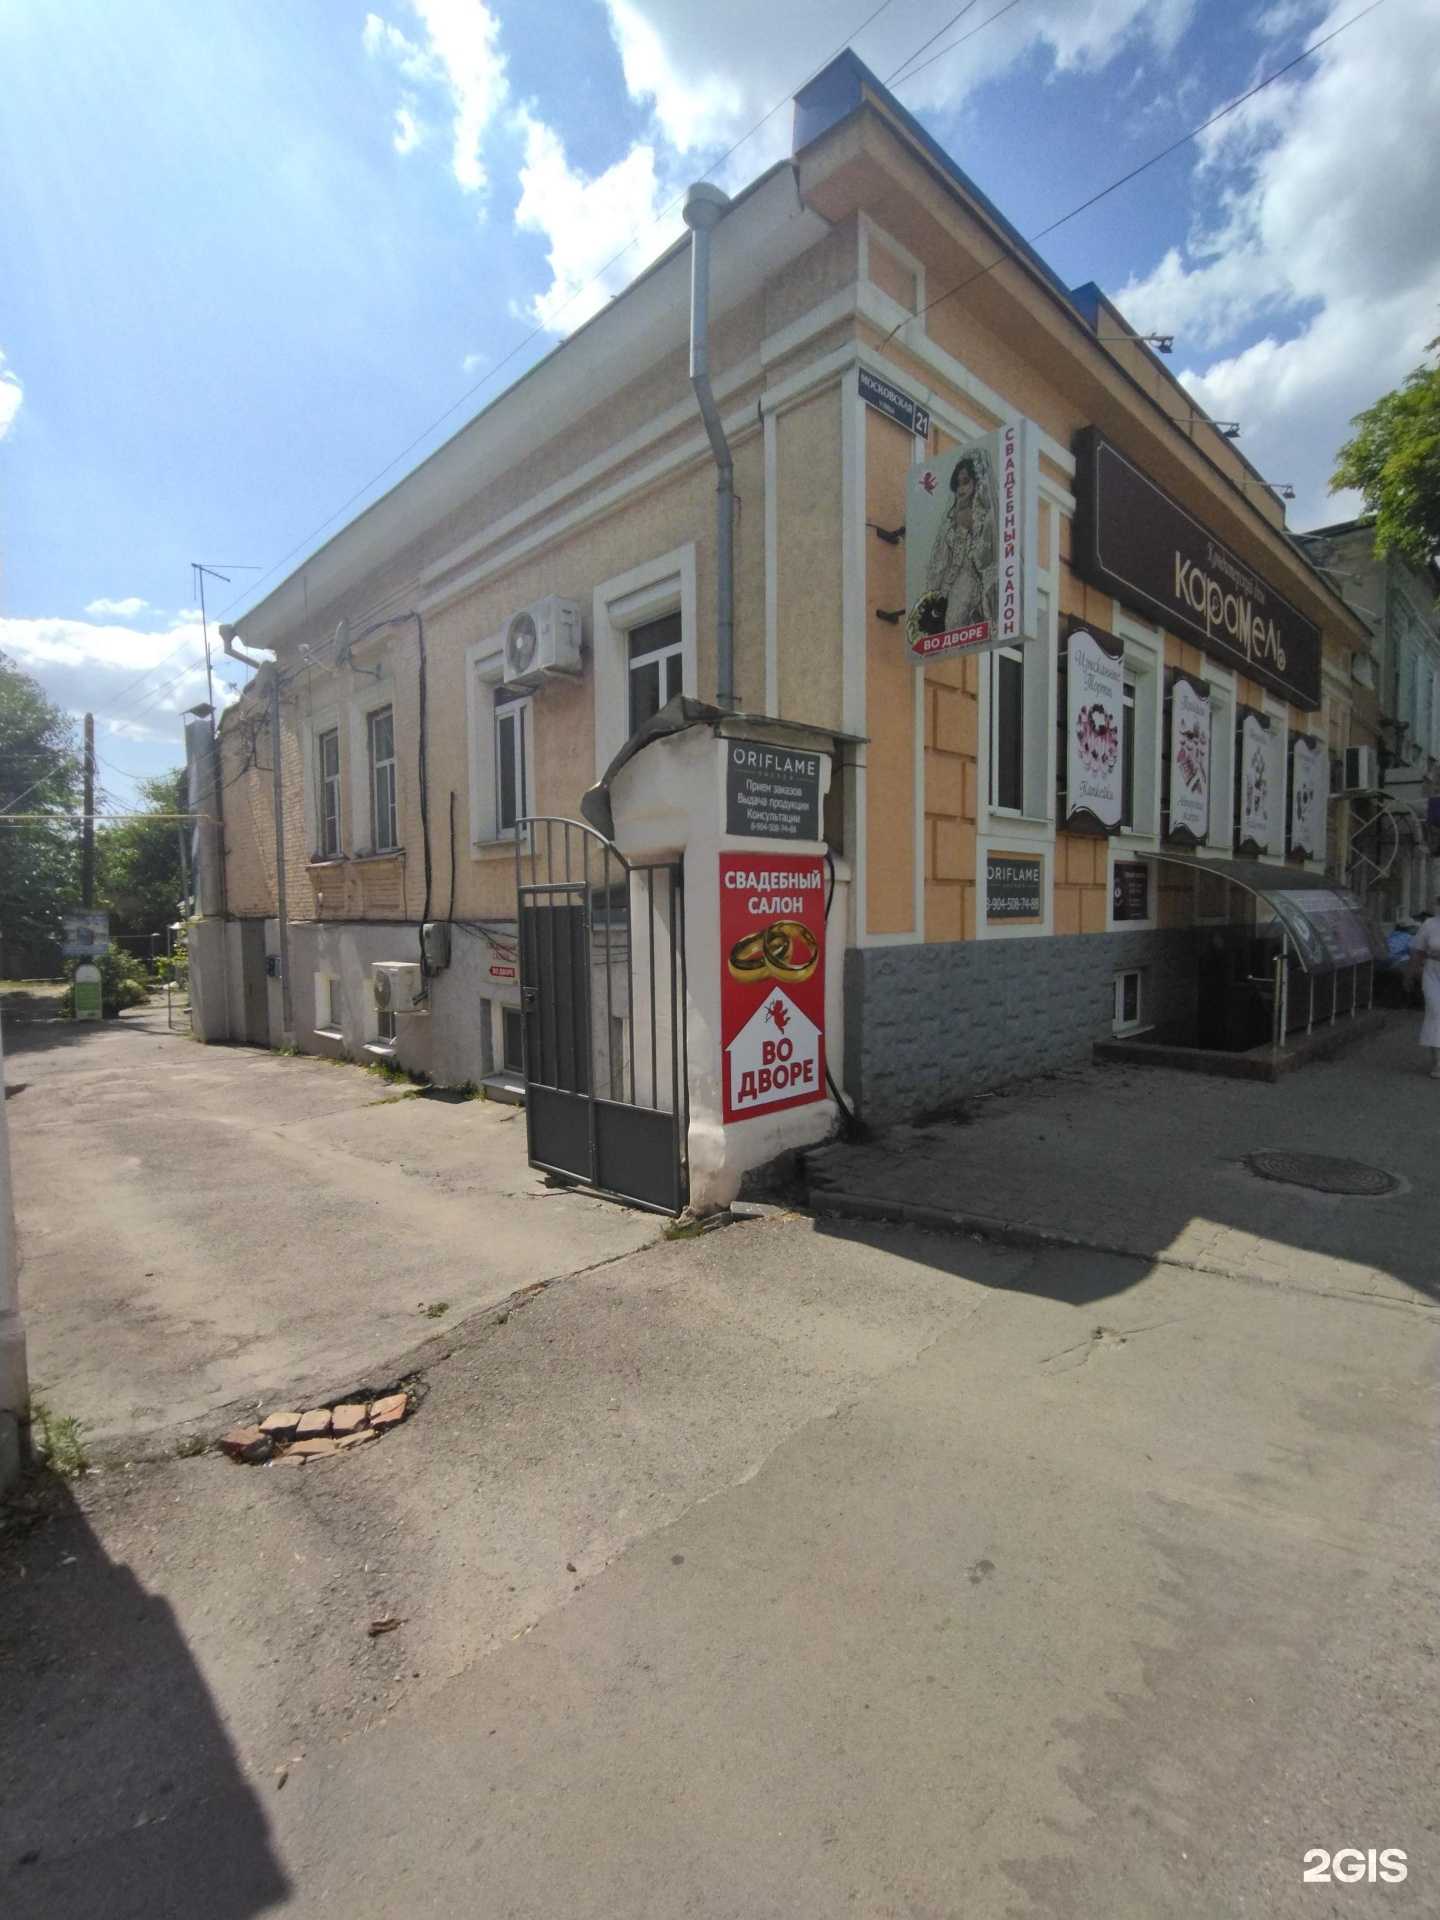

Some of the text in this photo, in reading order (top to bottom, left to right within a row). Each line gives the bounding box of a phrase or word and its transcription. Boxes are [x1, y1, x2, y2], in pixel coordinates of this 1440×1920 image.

[861, 374, 912, 414] МОСКОВСКАЯ
[916, 412, 928, 434] 21
[1004, 427, 1016, 634] СВАДЕБНЫЙ САЛОН
[923, 626, 984, 651] ВО ДВОРЕ
[733, 747, 816, 776] ORIFLAME
[746, 808, 800, 823] Консультации
[724, 869, 821, 892] СВАДЕБНЫЙ
[986, 866, 1040, 881] ORIFLAME
[748, 896, 803, 914] САЛОН
[762, 1038, 793, 1065] ВО
[738, 1059, 814, 1103] ДВОРЕ
